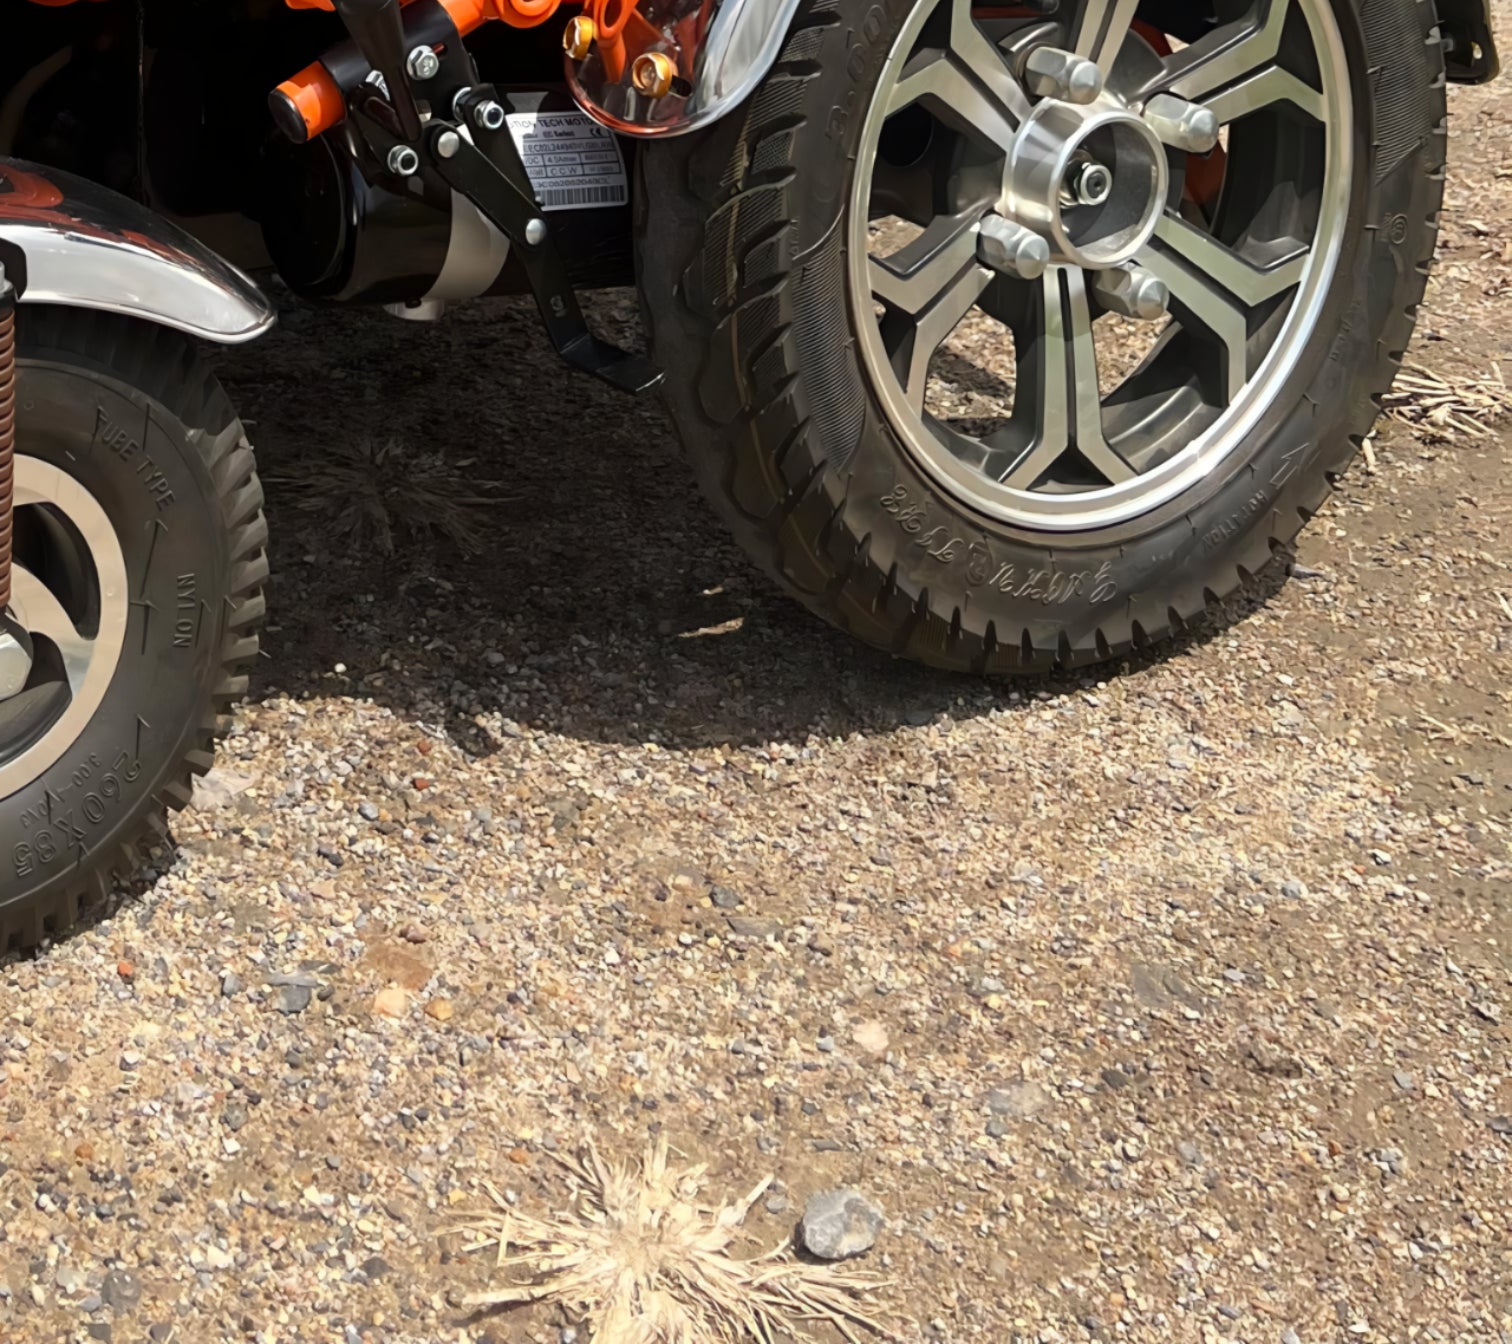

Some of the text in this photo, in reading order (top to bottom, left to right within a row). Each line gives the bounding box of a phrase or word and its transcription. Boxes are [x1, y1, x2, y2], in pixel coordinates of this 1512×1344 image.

[538, 118, 563, 128] TECH
[135, 454, 178, 512] TYPE
[172, 573, 196, 648] NYLON
